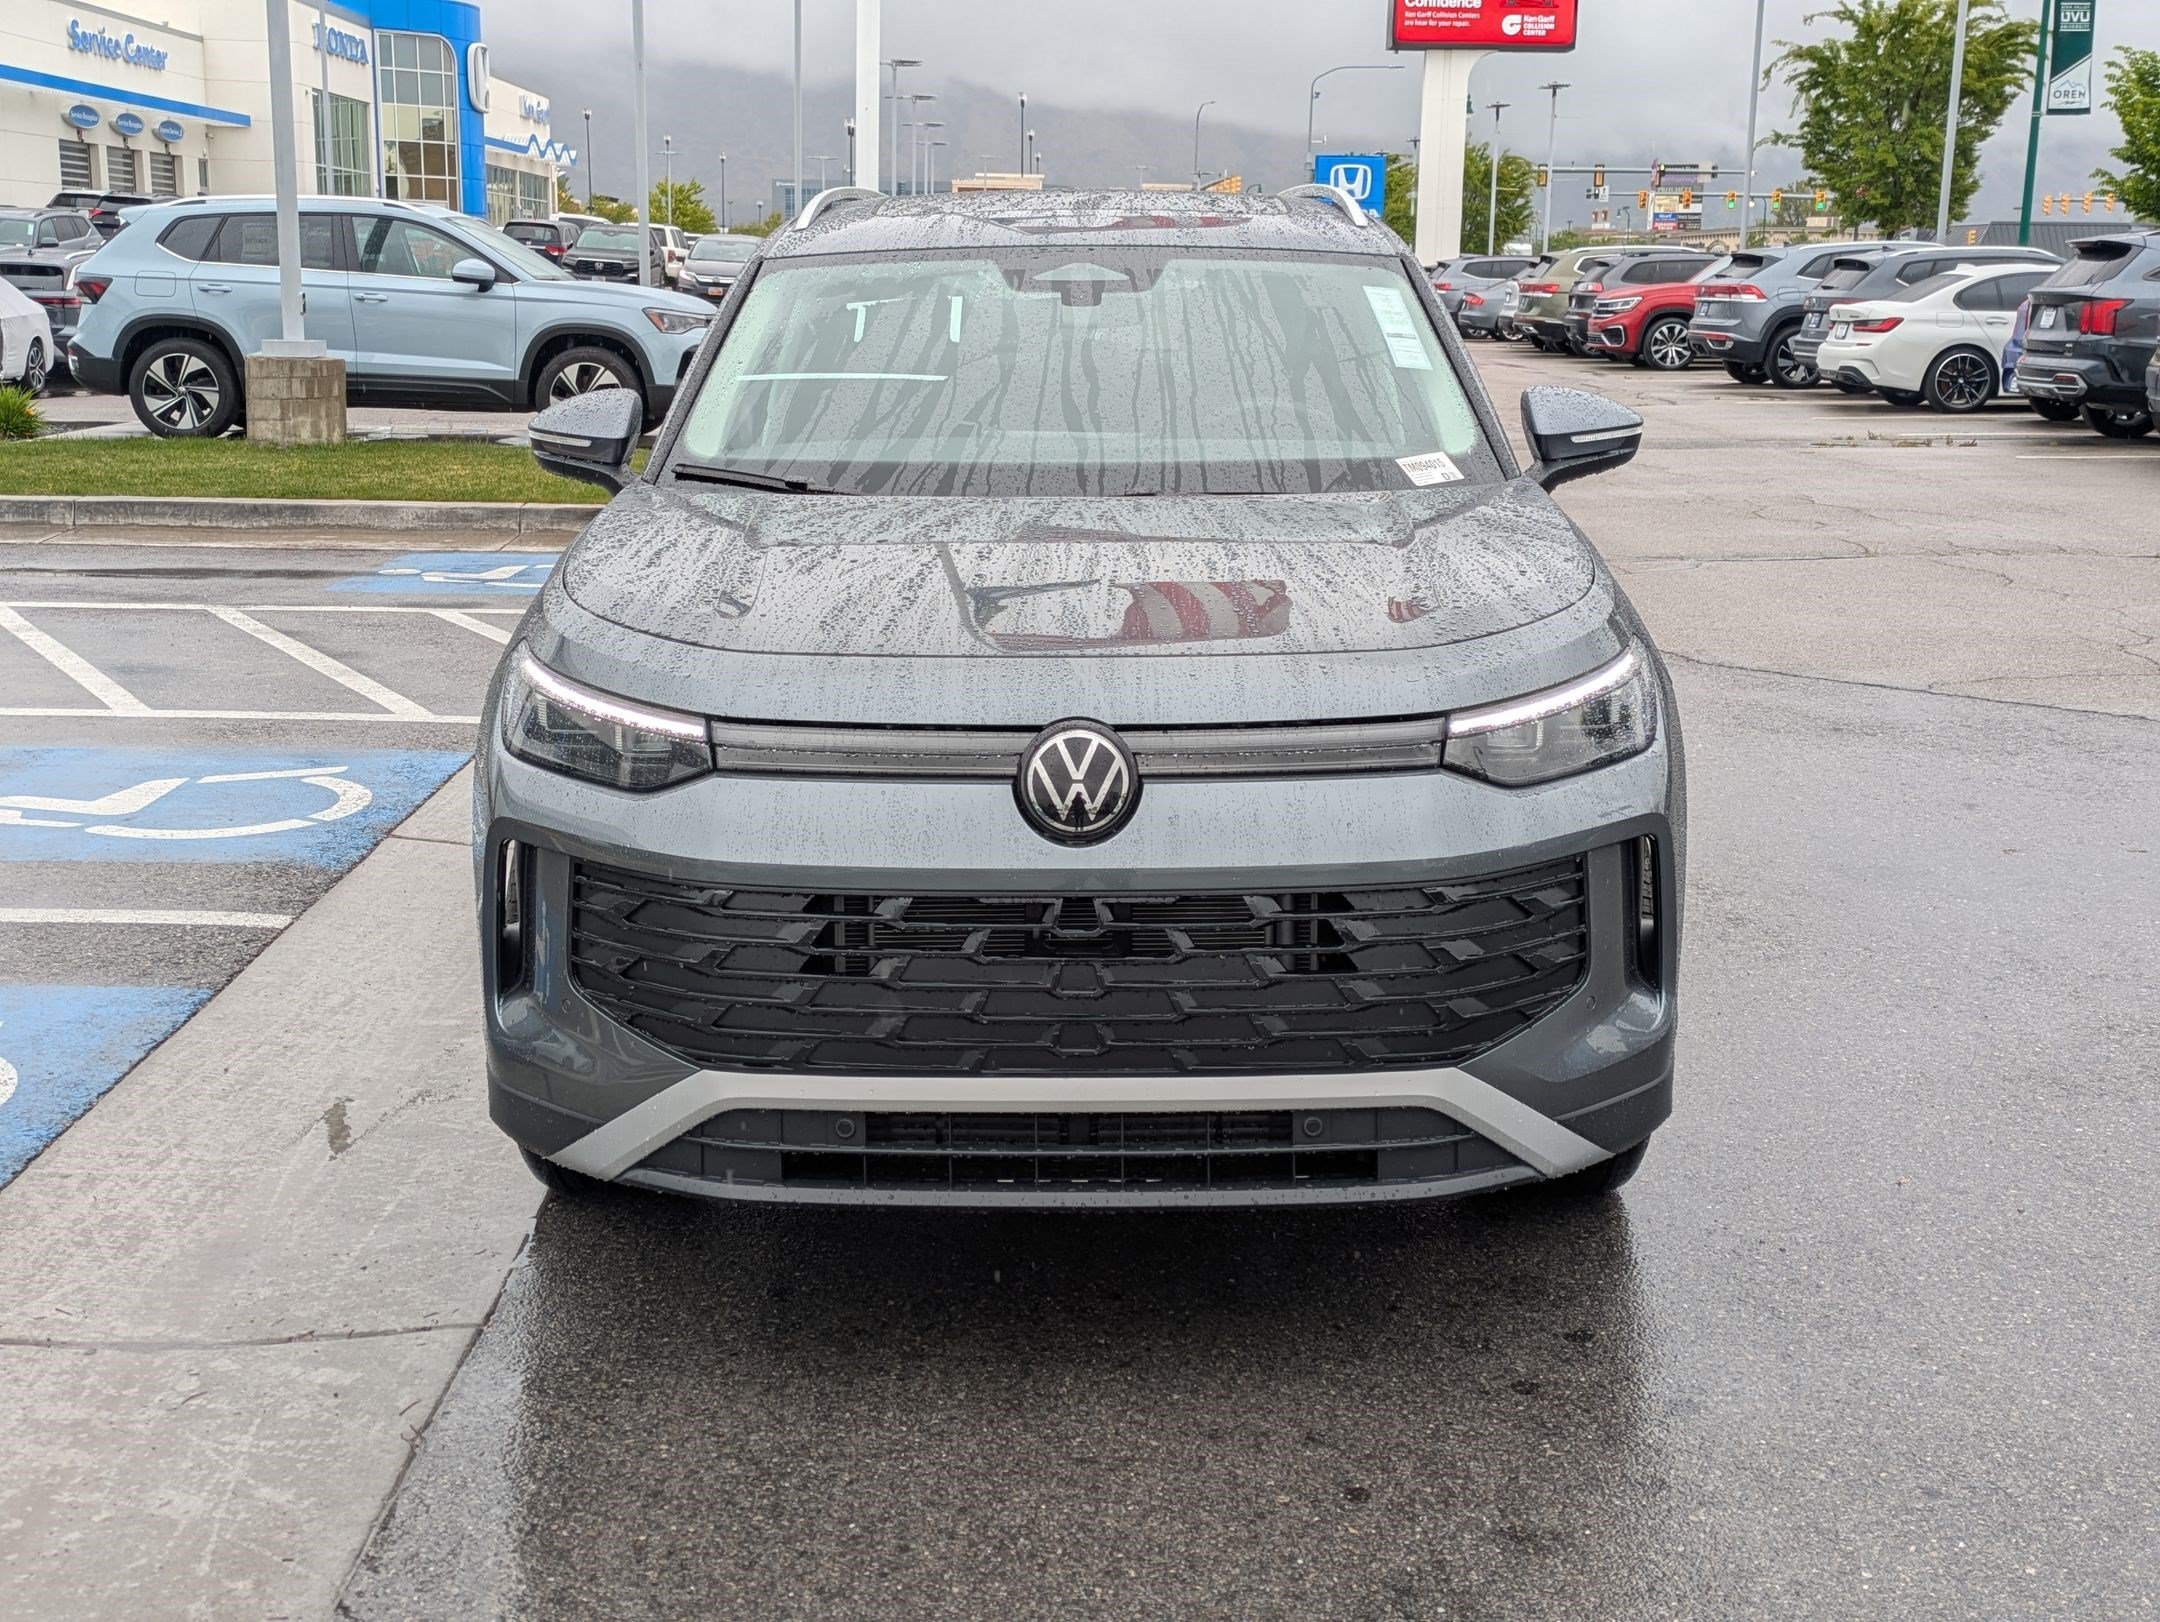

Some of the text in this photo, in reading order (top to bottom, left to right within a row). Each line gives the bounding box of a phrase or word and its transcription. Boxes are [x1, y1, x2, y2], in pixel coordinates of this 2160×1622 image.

[2061, 11, 2090, 22] UVU
[67, 18, 168, 71] Service Center
[1402, 458, 1446, 473] TM094015
